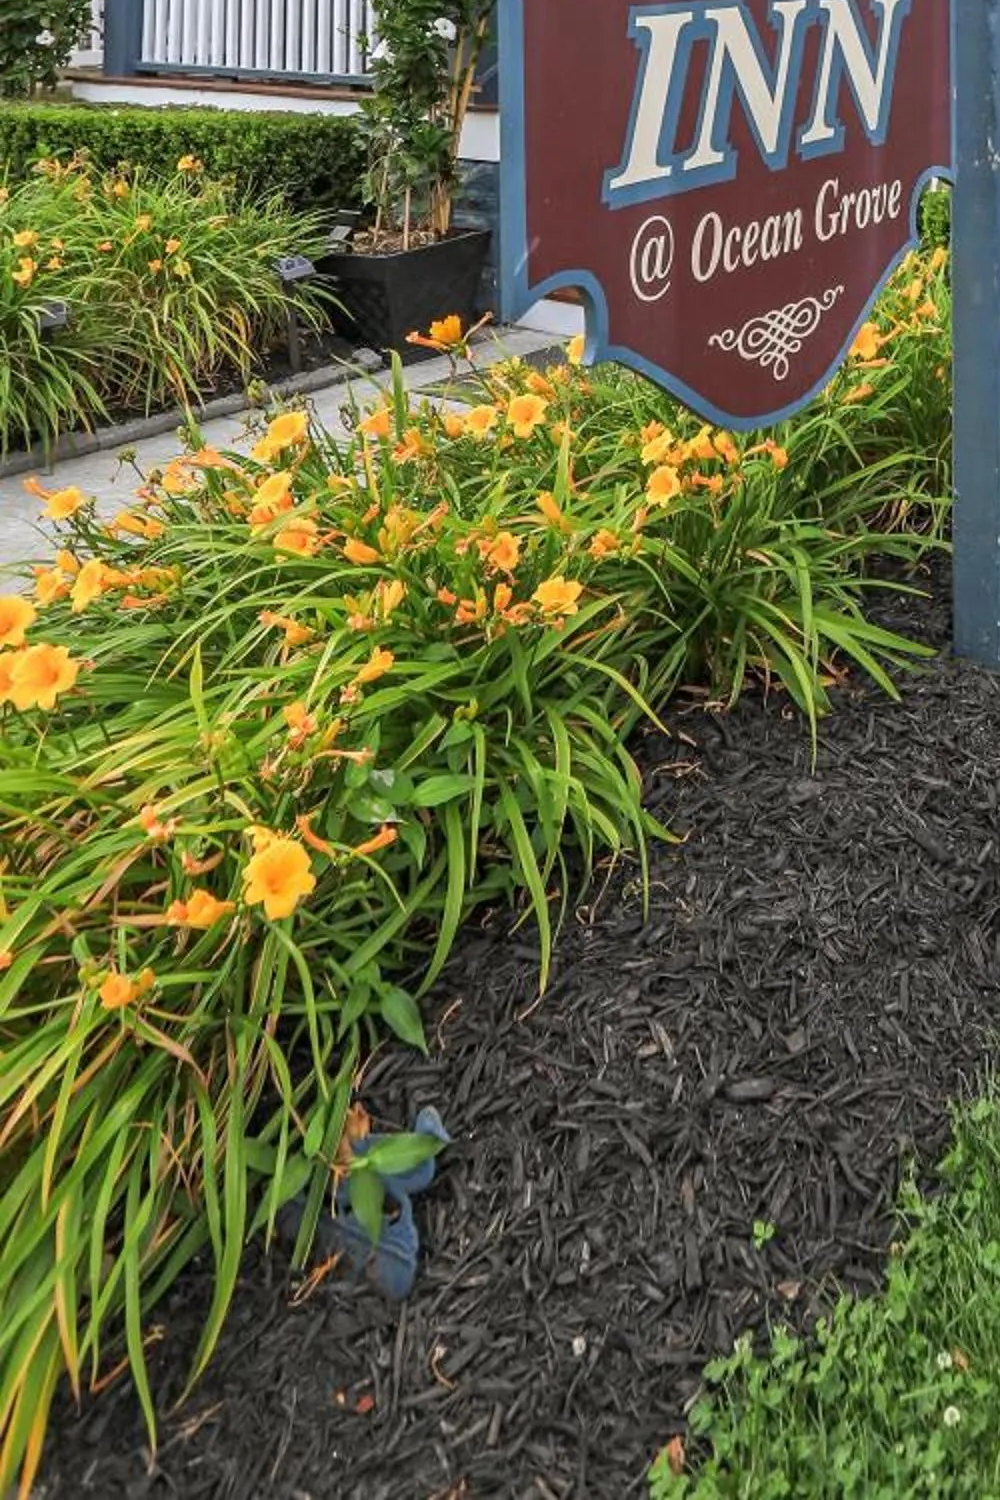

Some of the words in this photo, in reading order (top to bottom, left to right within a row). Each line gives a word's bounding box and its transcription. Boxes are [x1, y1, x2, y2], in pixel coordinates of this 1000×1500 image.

[629, 215, 674, 302] @
[691, 208, 803, 283] Ocean
[815, 178, 902, 242] Grove
